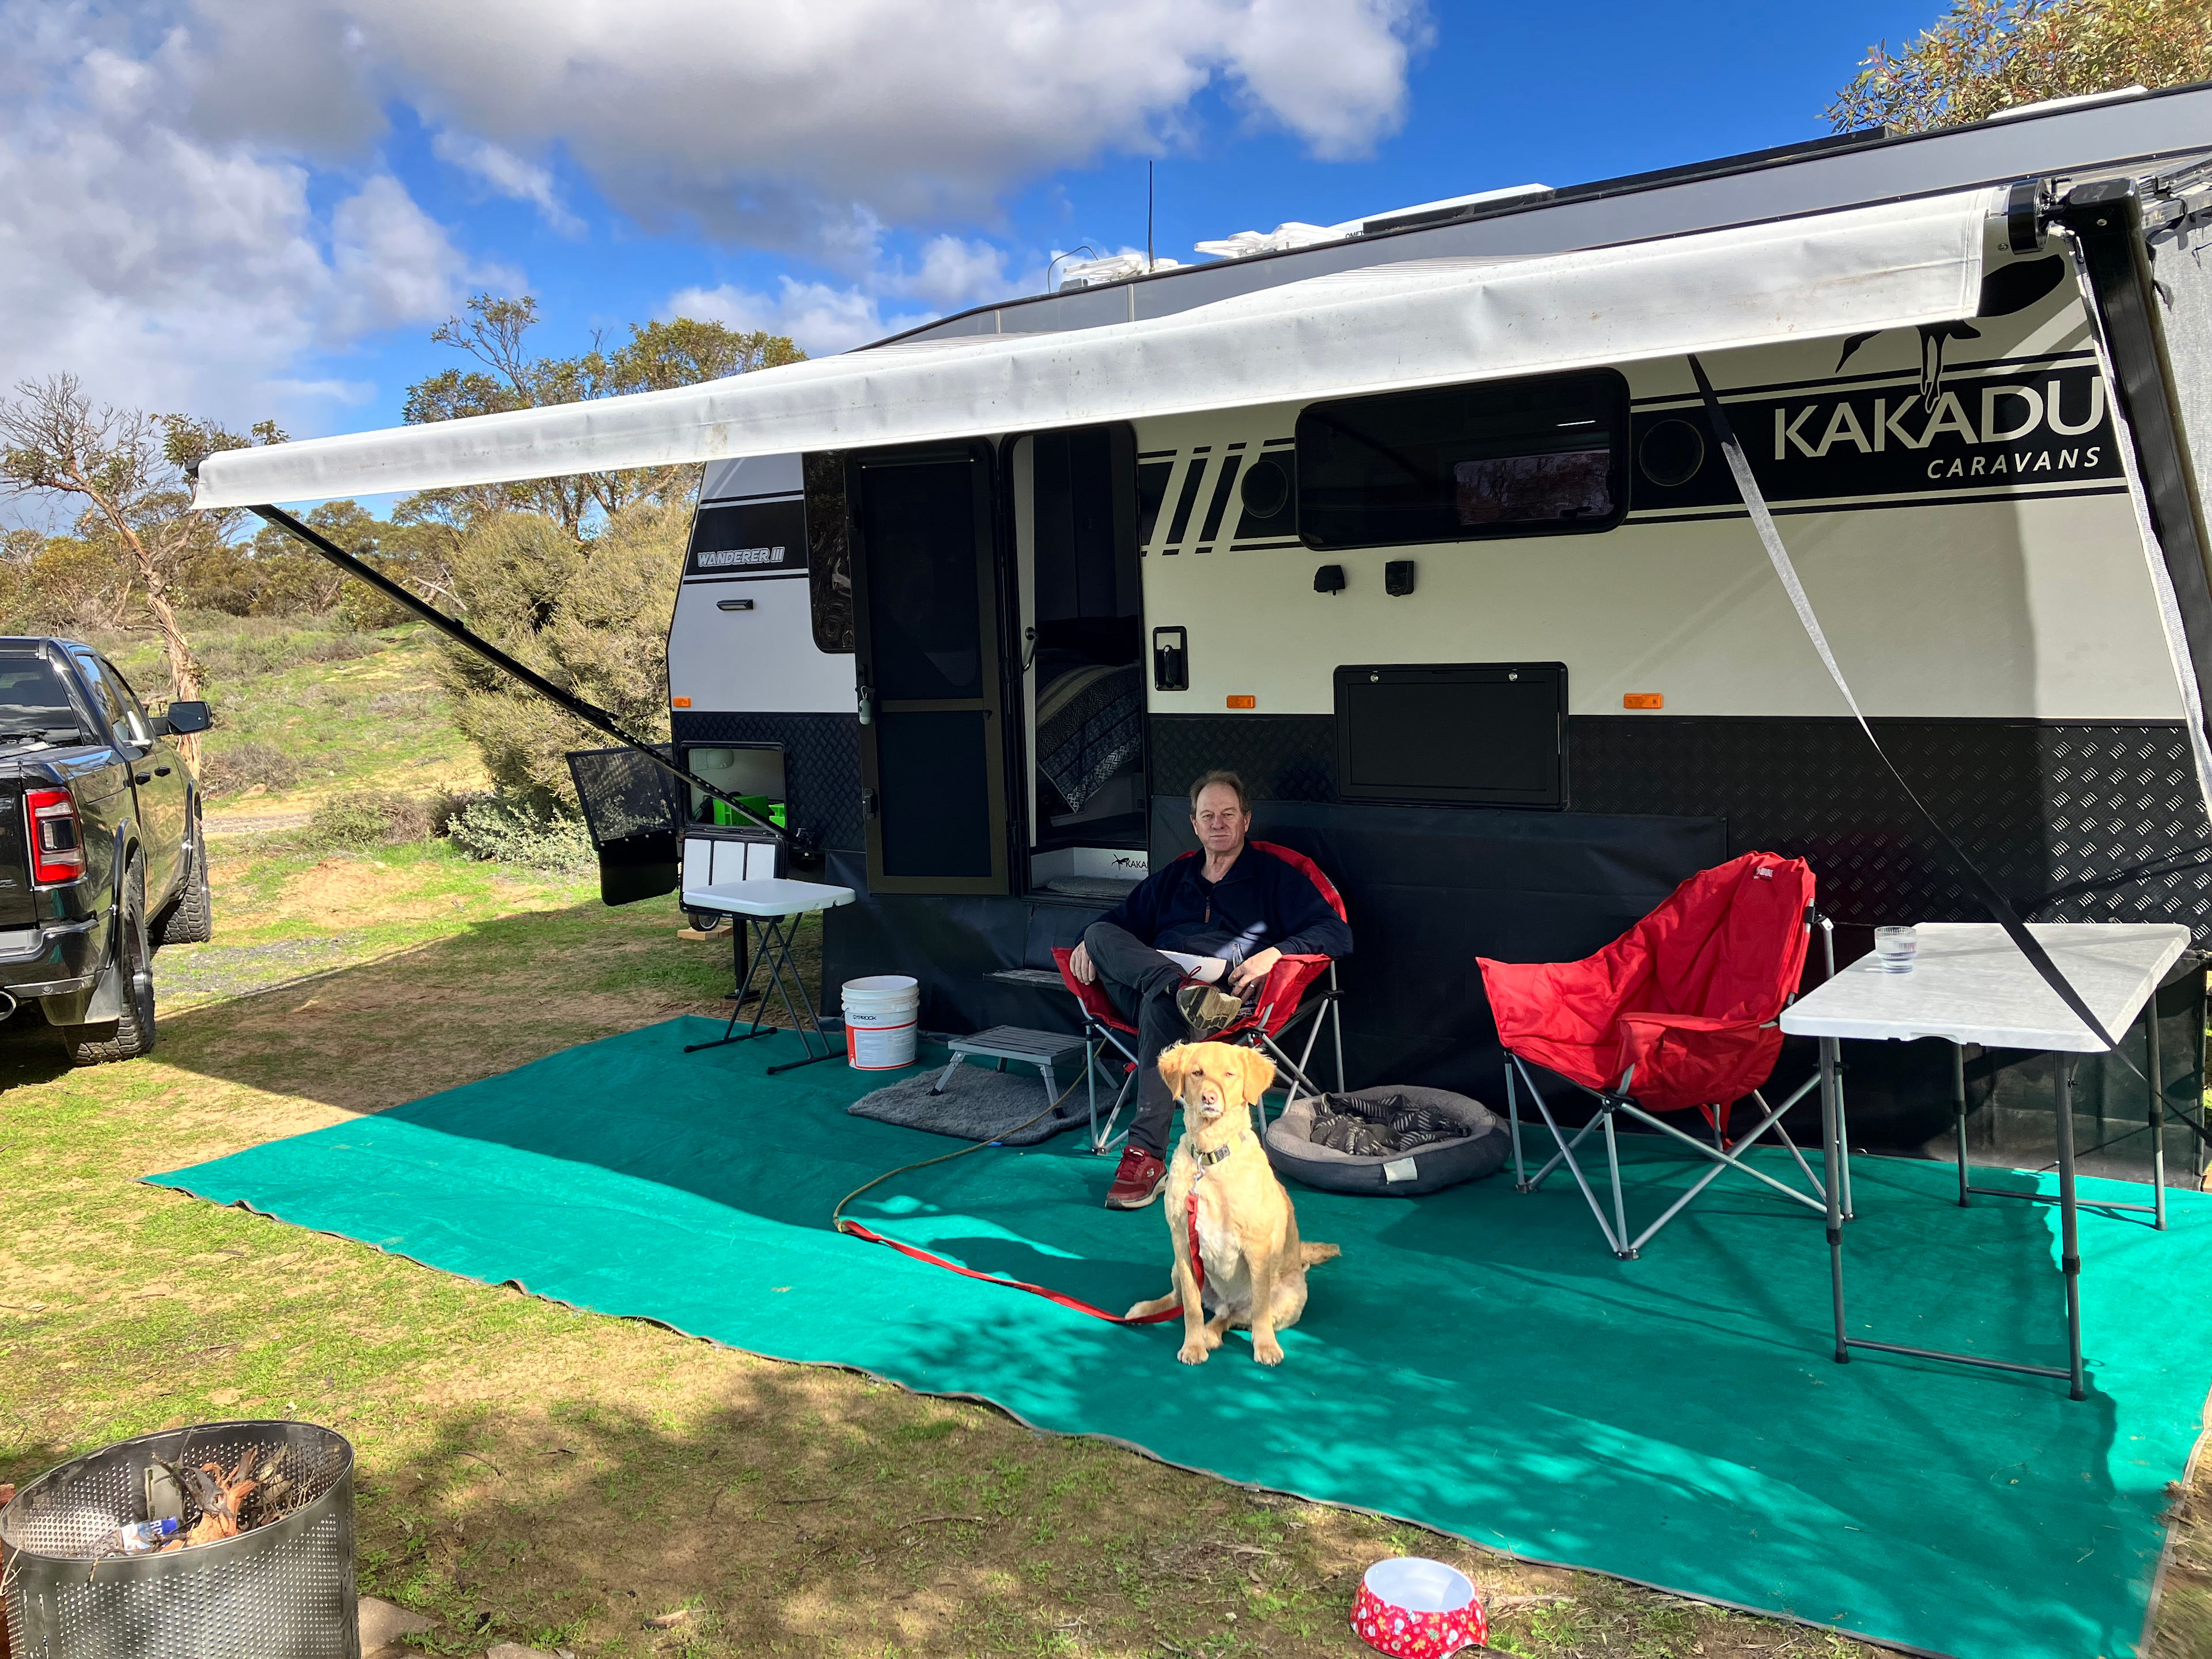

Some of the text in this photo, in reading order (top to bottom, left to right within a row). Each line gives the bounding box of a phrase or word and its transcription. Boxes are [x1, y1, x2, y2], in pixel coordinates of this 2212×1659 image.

[1775, 376, 2104, 460] KAKADU
[1927, 447, 2100, 479] CARAVANS
[698, 547, 785, 567] WANDERER III
[1126, 860, 1149, 869] KAKA
